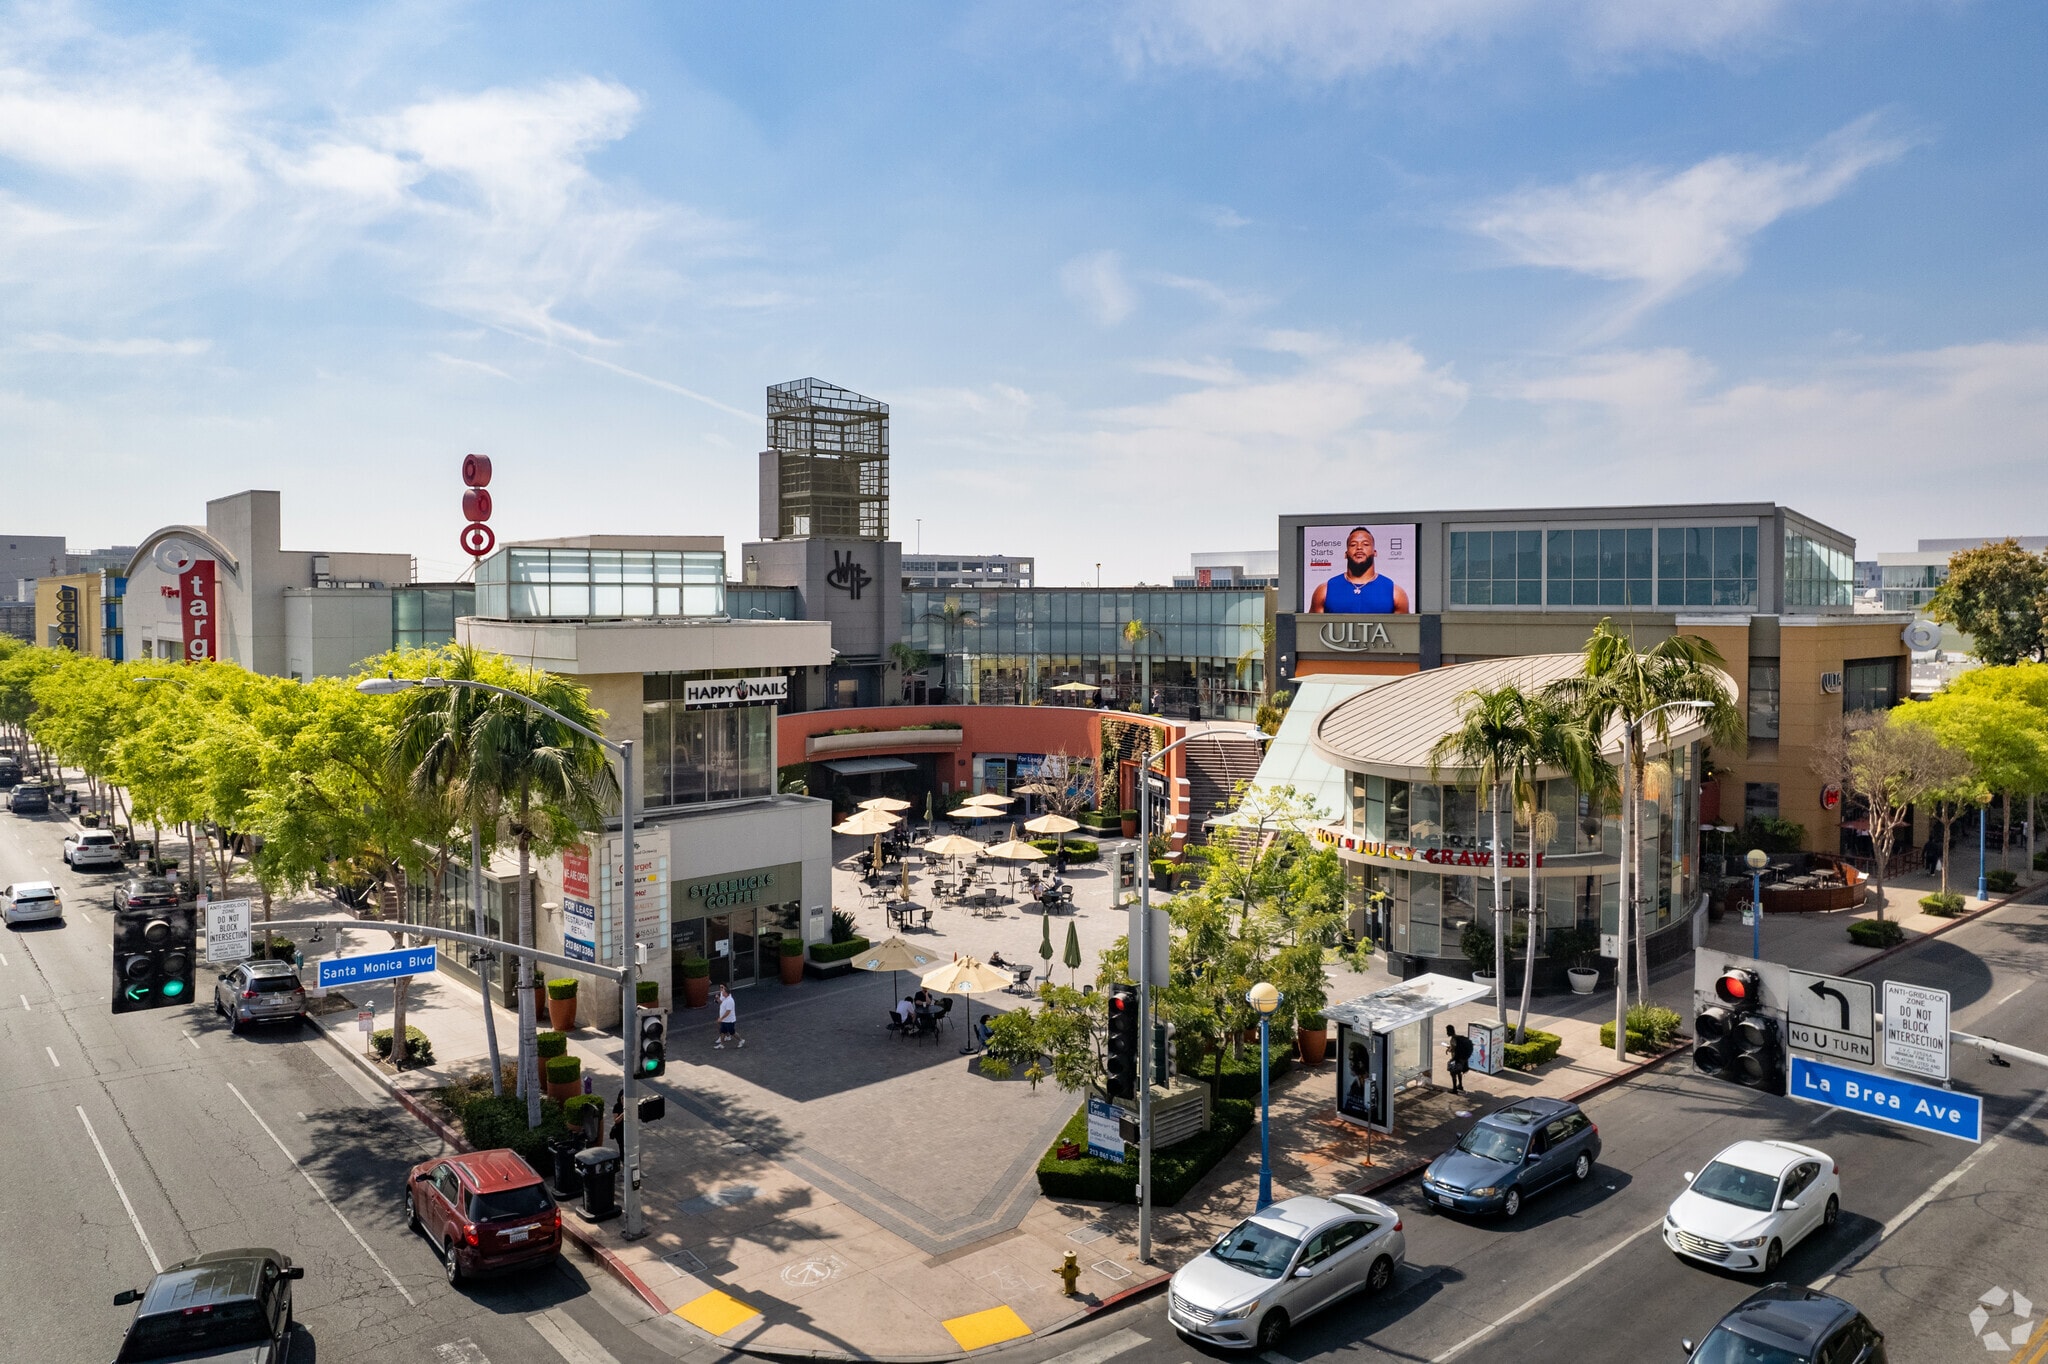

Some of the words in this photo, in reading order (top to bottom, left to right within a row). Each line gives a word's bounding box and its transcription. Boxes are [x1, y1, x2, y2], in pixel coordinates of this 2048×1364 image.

[62, 591, 74, 633] BEST
[1328, 622, 1390, 643] ULTA
[688, 685, 735, 700] HAPPY
[749, 682, 787, 697] NAILS
[1315, 828, 1341, 847] HOT
[1357, 840, 1417, 861] JUICY
[1424, 847, 1543, 868] CRAWIS
[634, 862, 652, 871] arget
[577, 871, 589, 883] OPEN
[690, 874, 776, 899] STARBUCKS
[210, 902, 247, 910] ANTI-GRIDLOCK
[706, 889, 760, 910] COFFEE
[565, 901, 575, 911] FOR
[576, 904, 593, 918] LEASE
[217, 916, 226, 924] DO
[229, 914, 239, 922] NOT
[565, 914, 593, 930] RESTAURANT
[220, 924, 237, 932] BLOCK
[571, 925, 586, 937] RETAIL
[210, 931, 247, 942] INTERSECTION
[323, 966, 357, 979] Santa
[364, 961, 402, 973] Monica
[409, 955, 433, 967] Blvd
[1889, 987, 1944, 1002] ANTI-GRIDLOCK
[1906, 998, 1925, 1006] ZONE
[1900, 1005, 1911, 1018] DO
[1916, 1008, 1932, 1021] NOT
[1903, 1019, 1928, 1033] BLOCK
[1792, 1030, 1809, 1042] NO
[1815, 1033, 1827, 1048] U
[1833, 1039, 1869, 1056] TURN
[1889, 1029, 1943, 1049] INTERSECTION
[1805, 1072, 1830, 1092] La
[1845, 1081, 1900, 1109] Brea
[1914, 1099, 1961, 1123] Ave
[1090, 1109, 1106, 1118] Lease
[1089, 1148, 1099, 1156] 213
